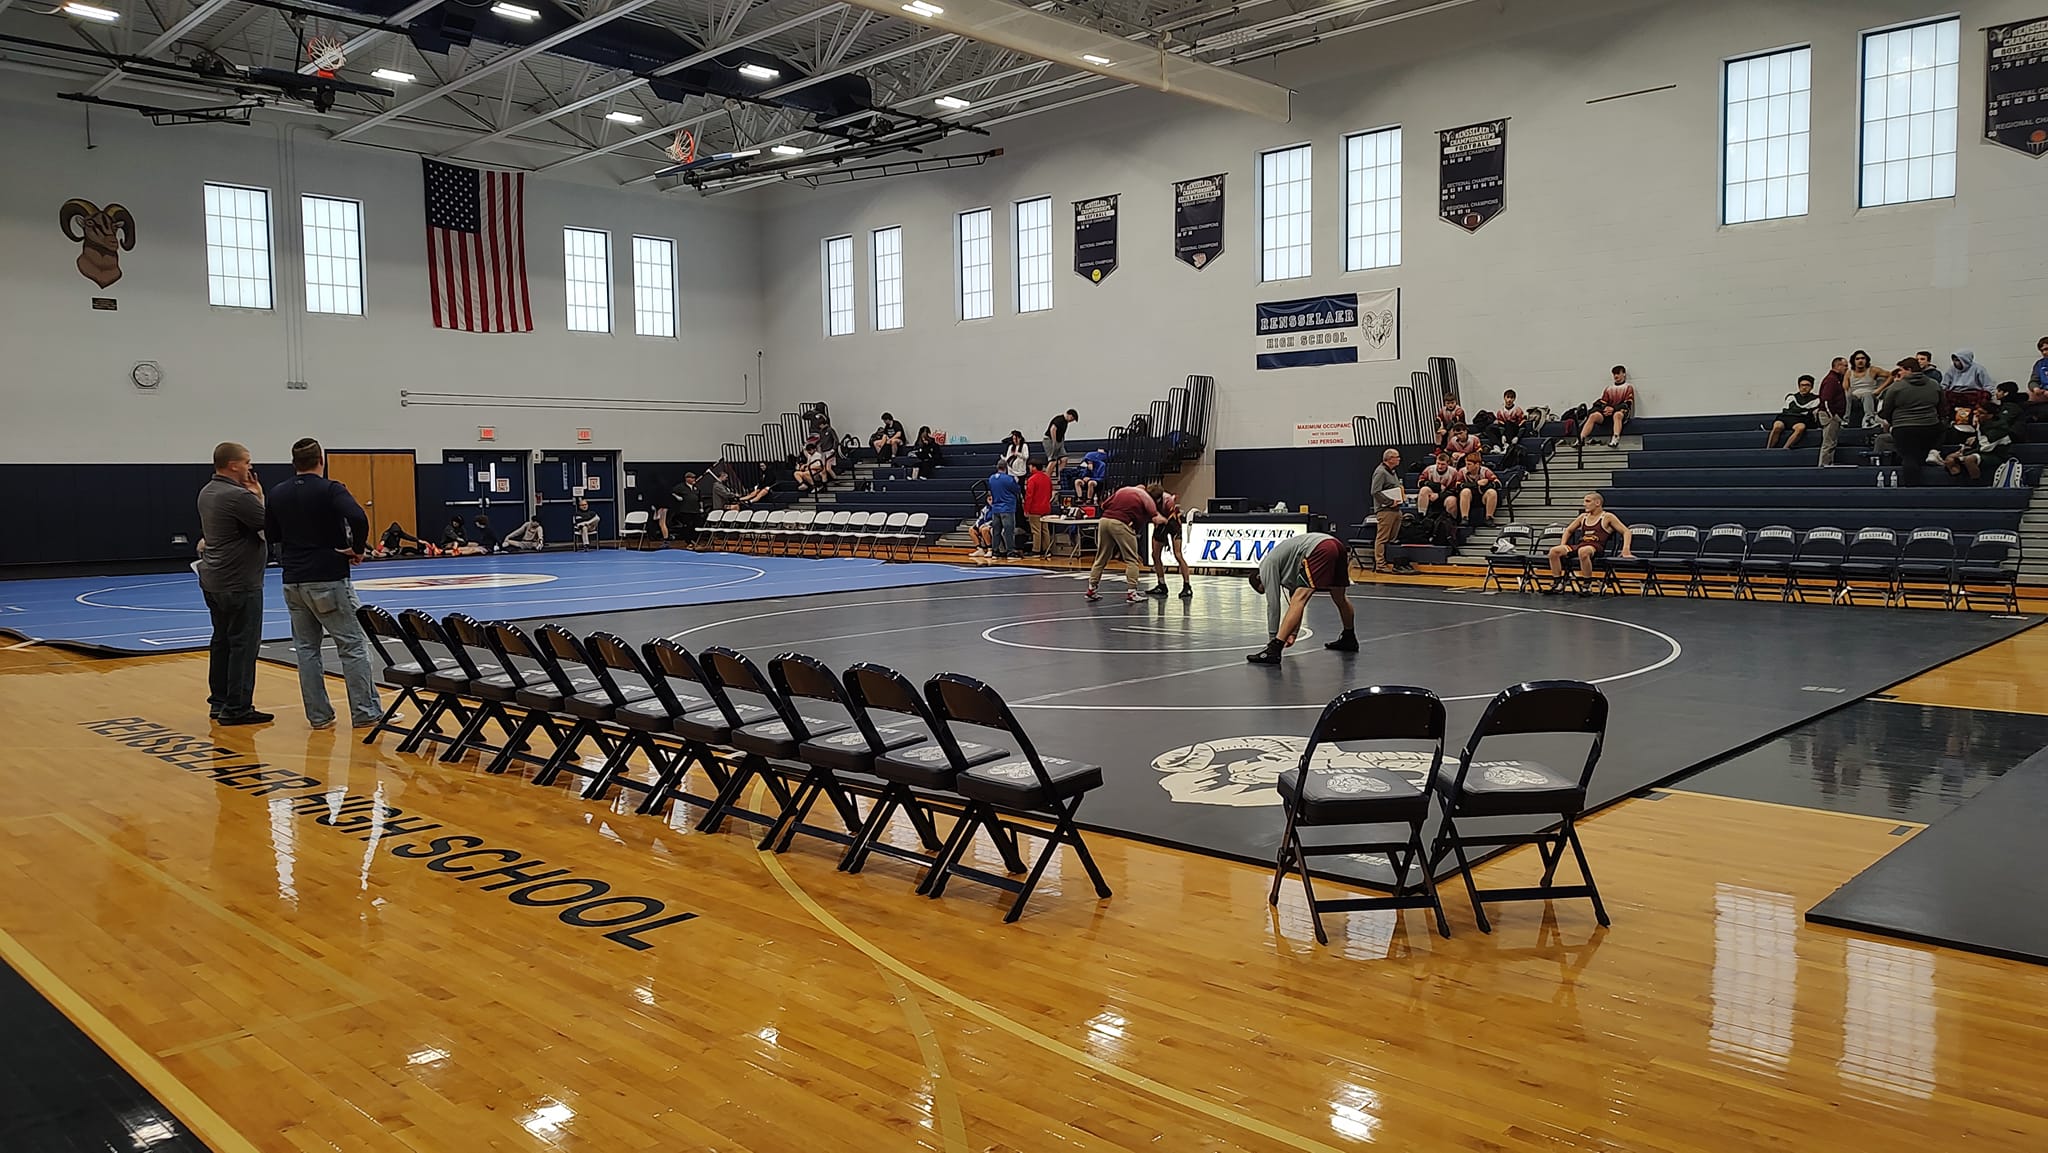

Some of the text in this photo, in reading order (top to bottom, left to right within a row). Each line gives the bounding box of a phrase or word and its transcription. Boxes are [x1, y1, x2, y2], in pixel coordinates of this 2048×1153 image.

[2001, 45, 2023, 55] BOYS
[1996, 119, 2034, 130] REGIONAL
[1455, 142, 1490, 151] FOOTBALL
[1260, 309, 1355, 331] RENSSELAER
[1266, 332, 1348, 349] HIGH SCHOOL
[1201, 540, 1276, 560] RAM
[77, 717, 322, 796] RENSSELAER
[391, 836, 699, 951] SCHOOL
